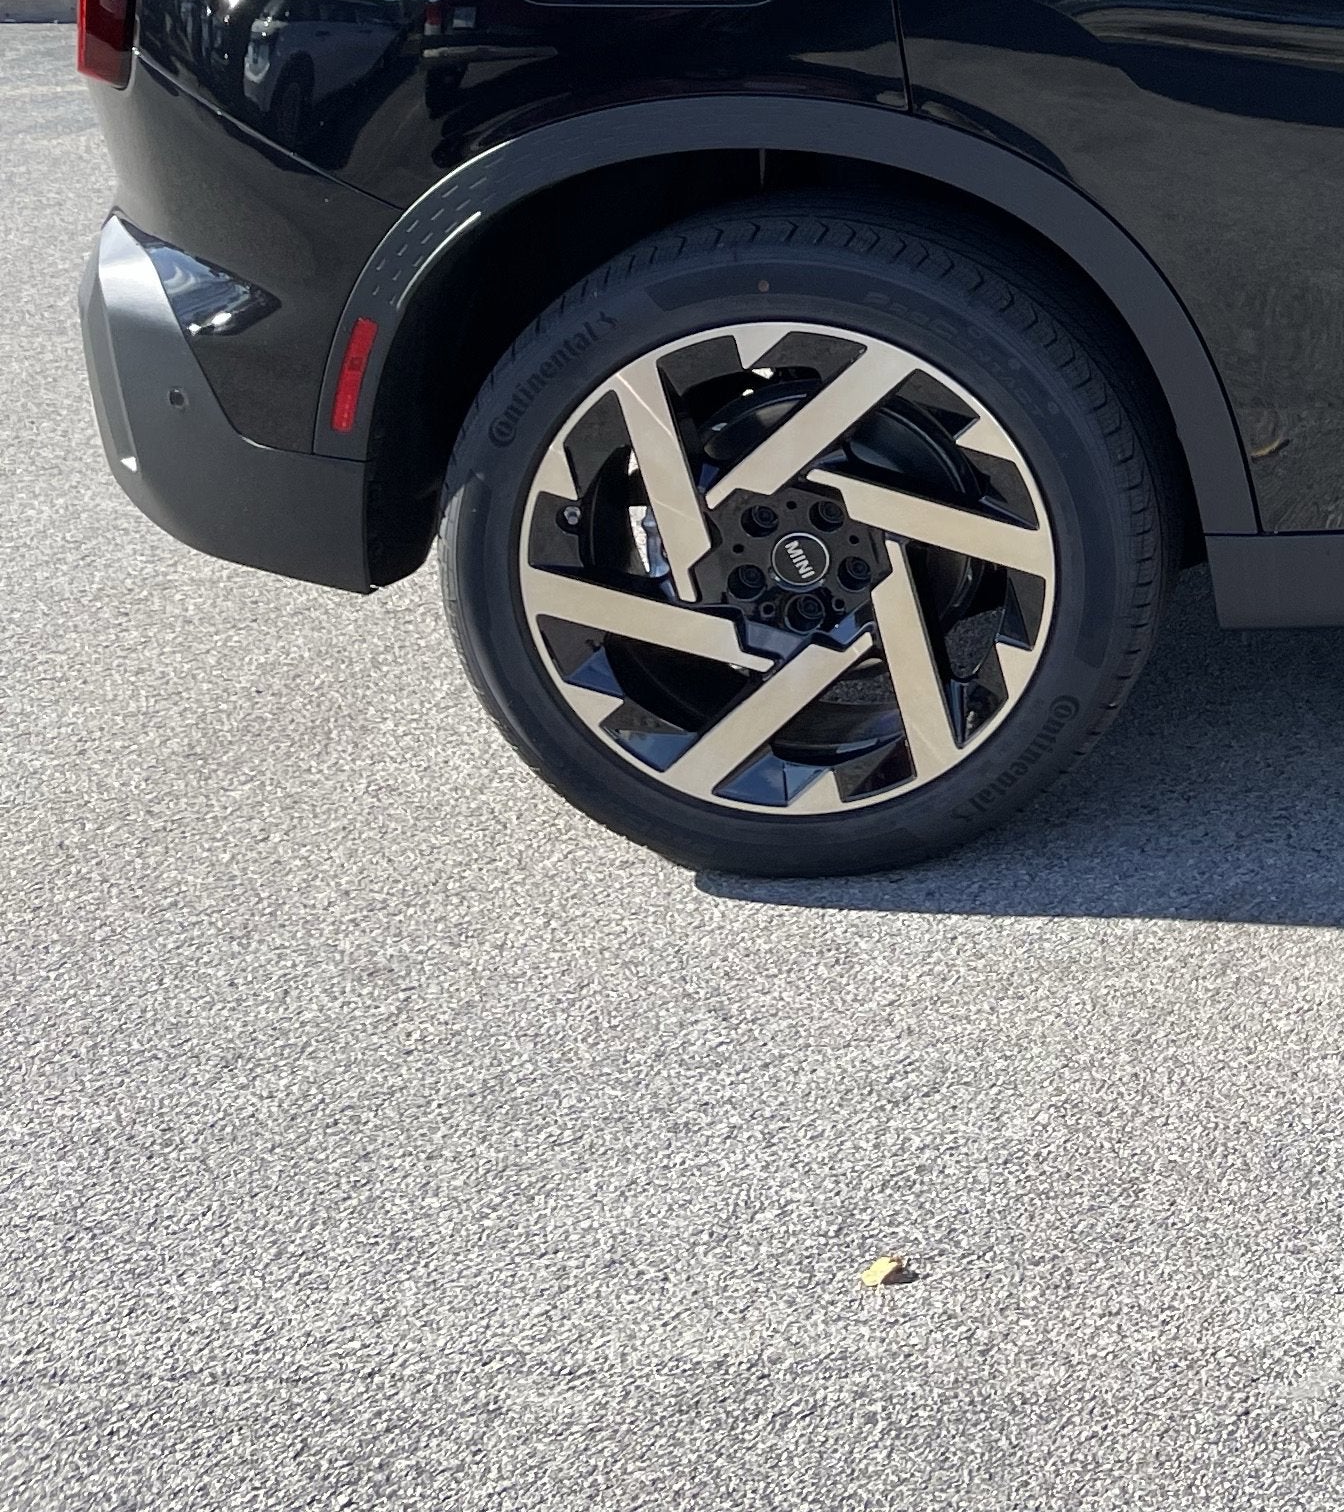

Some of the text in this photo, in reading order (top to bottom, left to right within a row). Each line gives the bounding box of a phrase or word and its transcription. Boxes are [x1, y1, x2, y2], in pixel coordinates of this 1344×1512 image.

[488, 321, 599, 448] Continental
[785, 540, 815, 579] MINI
[969, 695, 1080, 812] Continental
